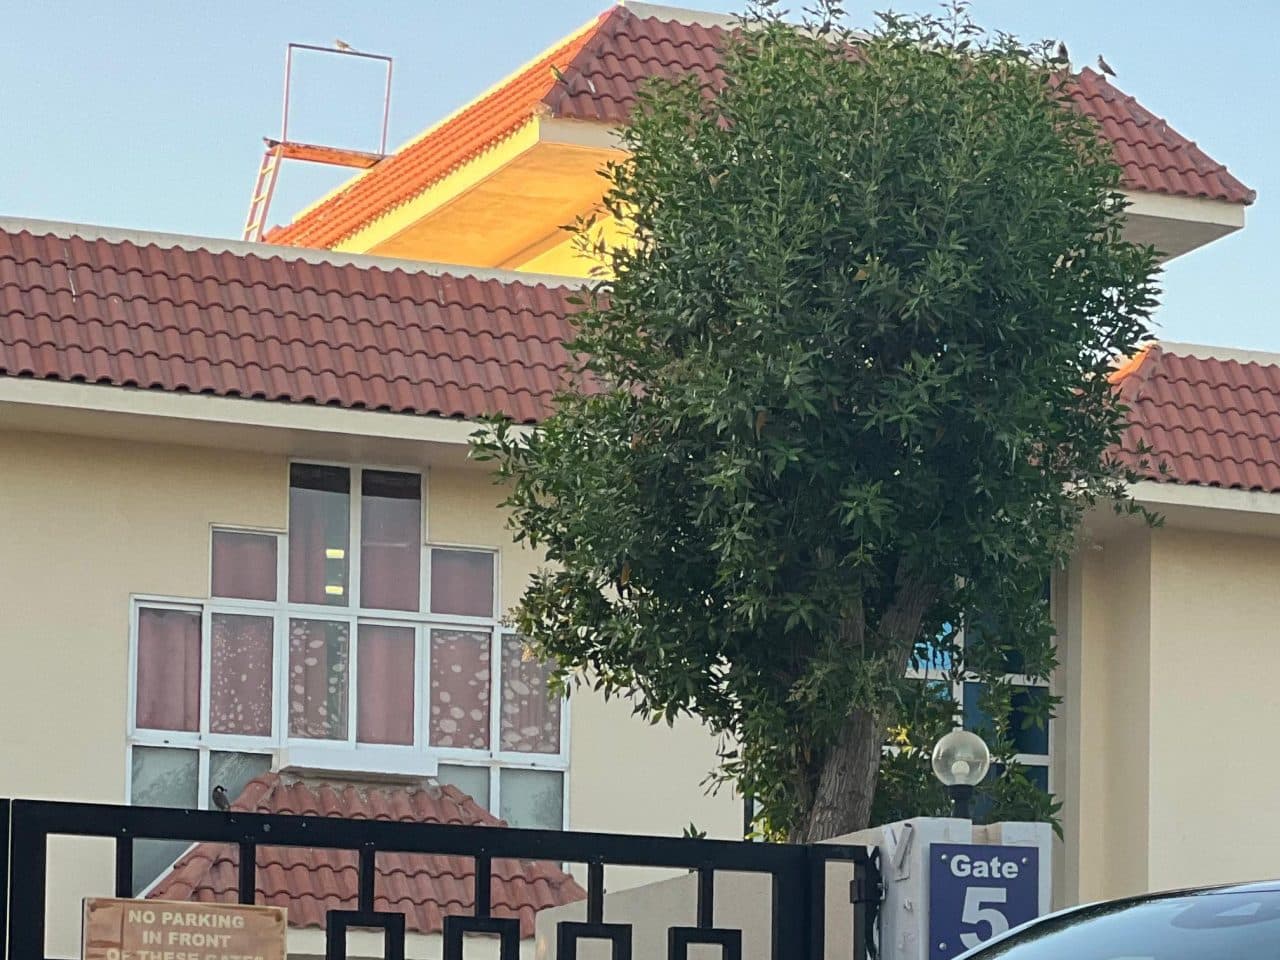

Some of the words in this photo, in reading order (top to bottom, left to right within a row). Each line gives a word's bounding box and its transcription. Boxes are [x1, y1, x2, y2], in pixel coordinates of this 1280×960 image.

[950, 854, 1019, 879] Gate
[128, 910, 155, 924] NO
[162, 911, 245, 929] PARKING
[959, 886, 1010, 950] 5
[142, 930, 162, 945] IN
[168, 931, 231, 948] FRONT
